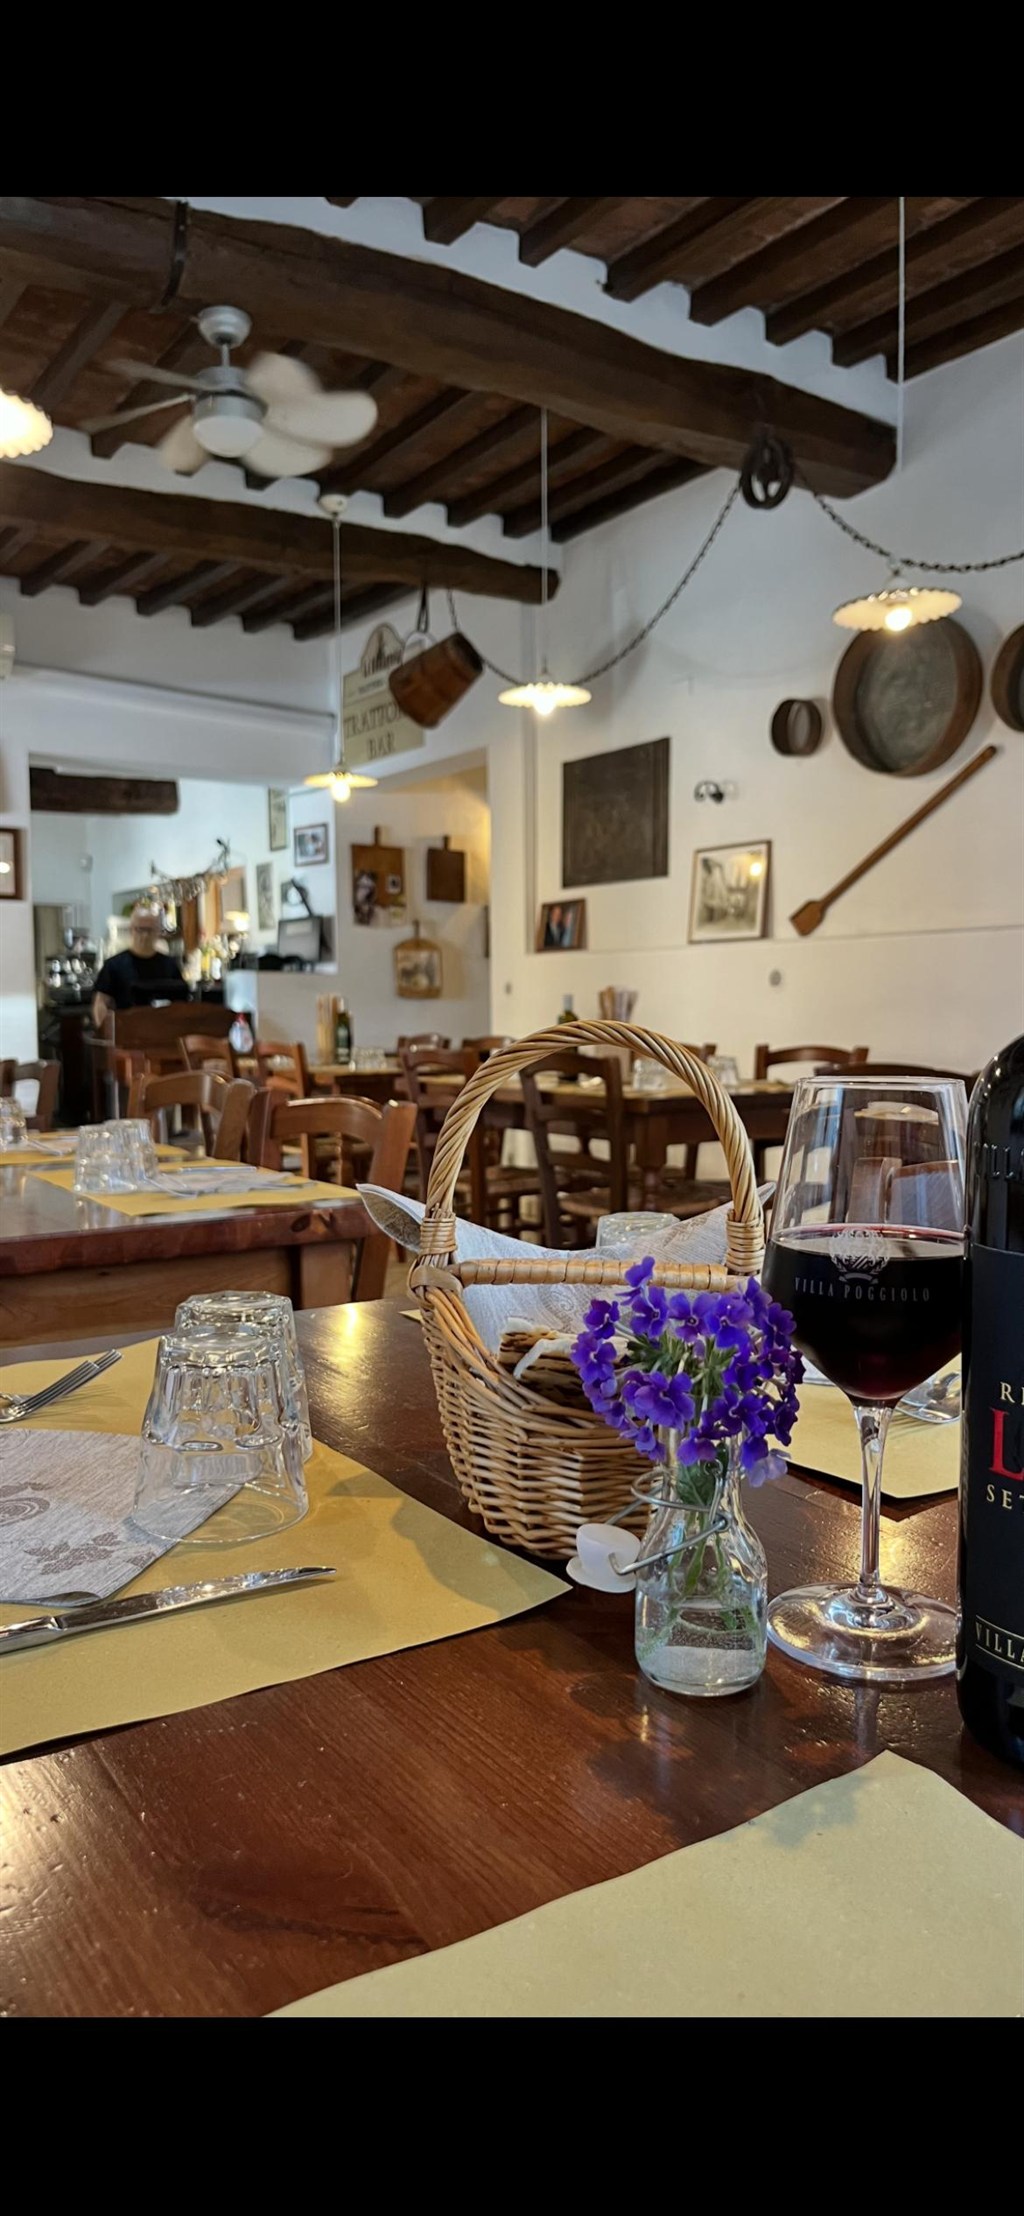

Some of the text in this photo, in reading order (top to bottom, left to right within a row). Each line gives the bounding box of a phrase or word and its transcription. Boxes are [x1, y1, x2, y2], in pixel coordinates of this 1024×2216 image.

[368, 731, 395, 760] BAR
[795, 1276, 930, 1302] VILLA POGGIOLO
